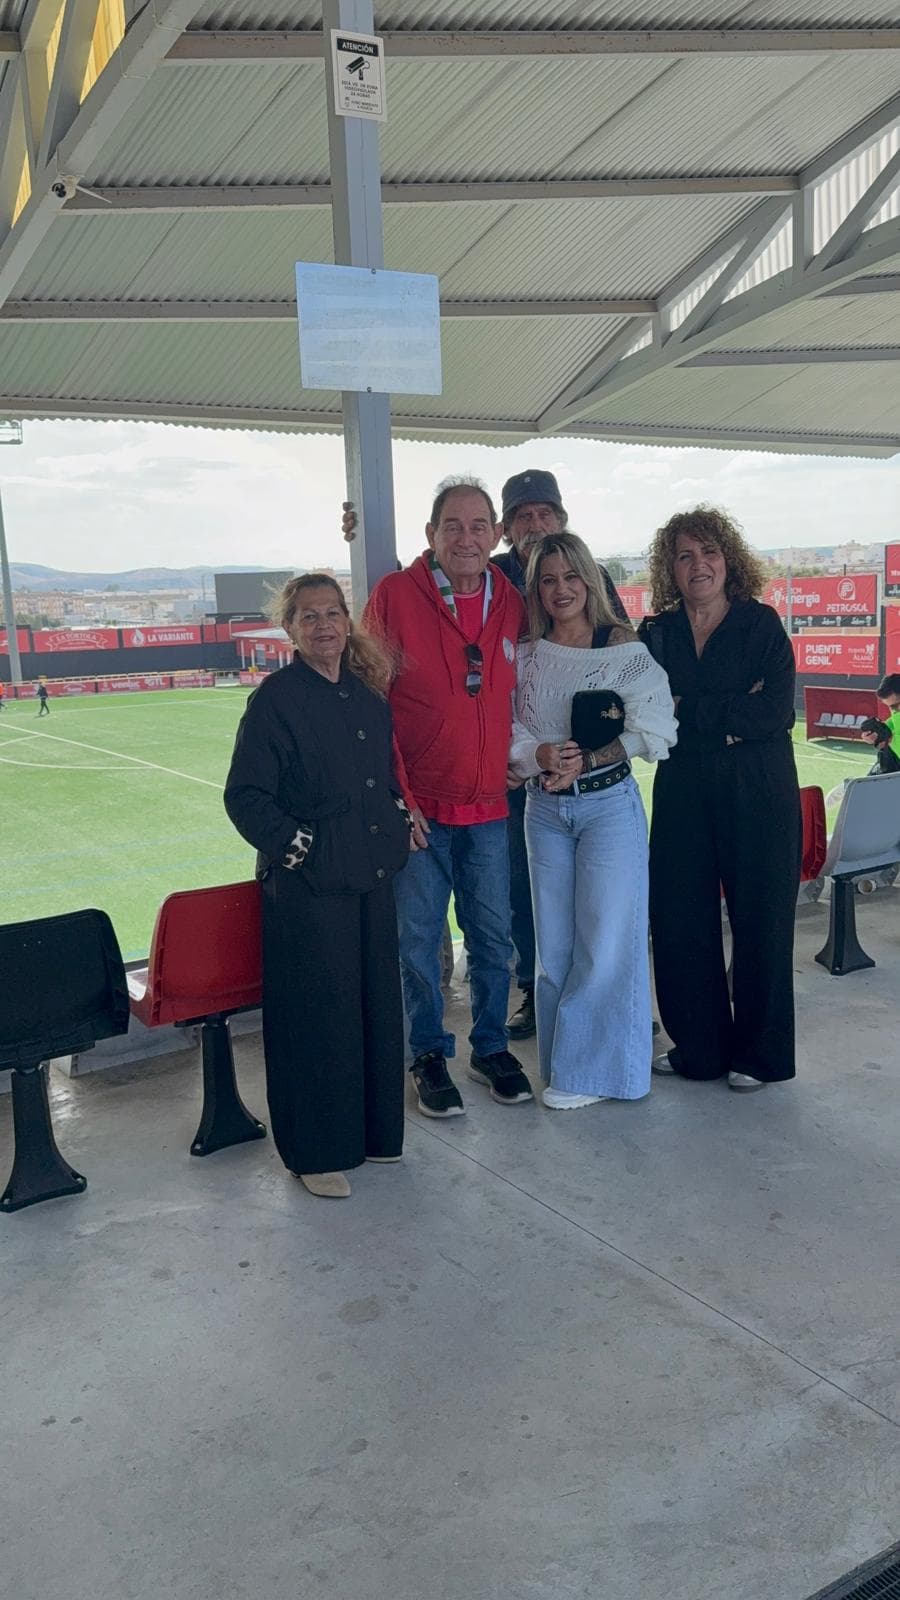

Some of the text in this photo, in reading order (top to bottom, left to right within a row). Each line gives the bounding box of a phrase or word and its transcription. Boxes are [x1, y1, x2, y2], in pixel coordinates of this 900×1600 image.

[342, 42, 373, 53] ATENCIÓN
[826, 603, 869, 613] PETROSOL
[147, 631, 194, 643] LA VARIANTE
[805, 644, 842, 655] PUENTE
[805, 655, 832, 666] GENIL
